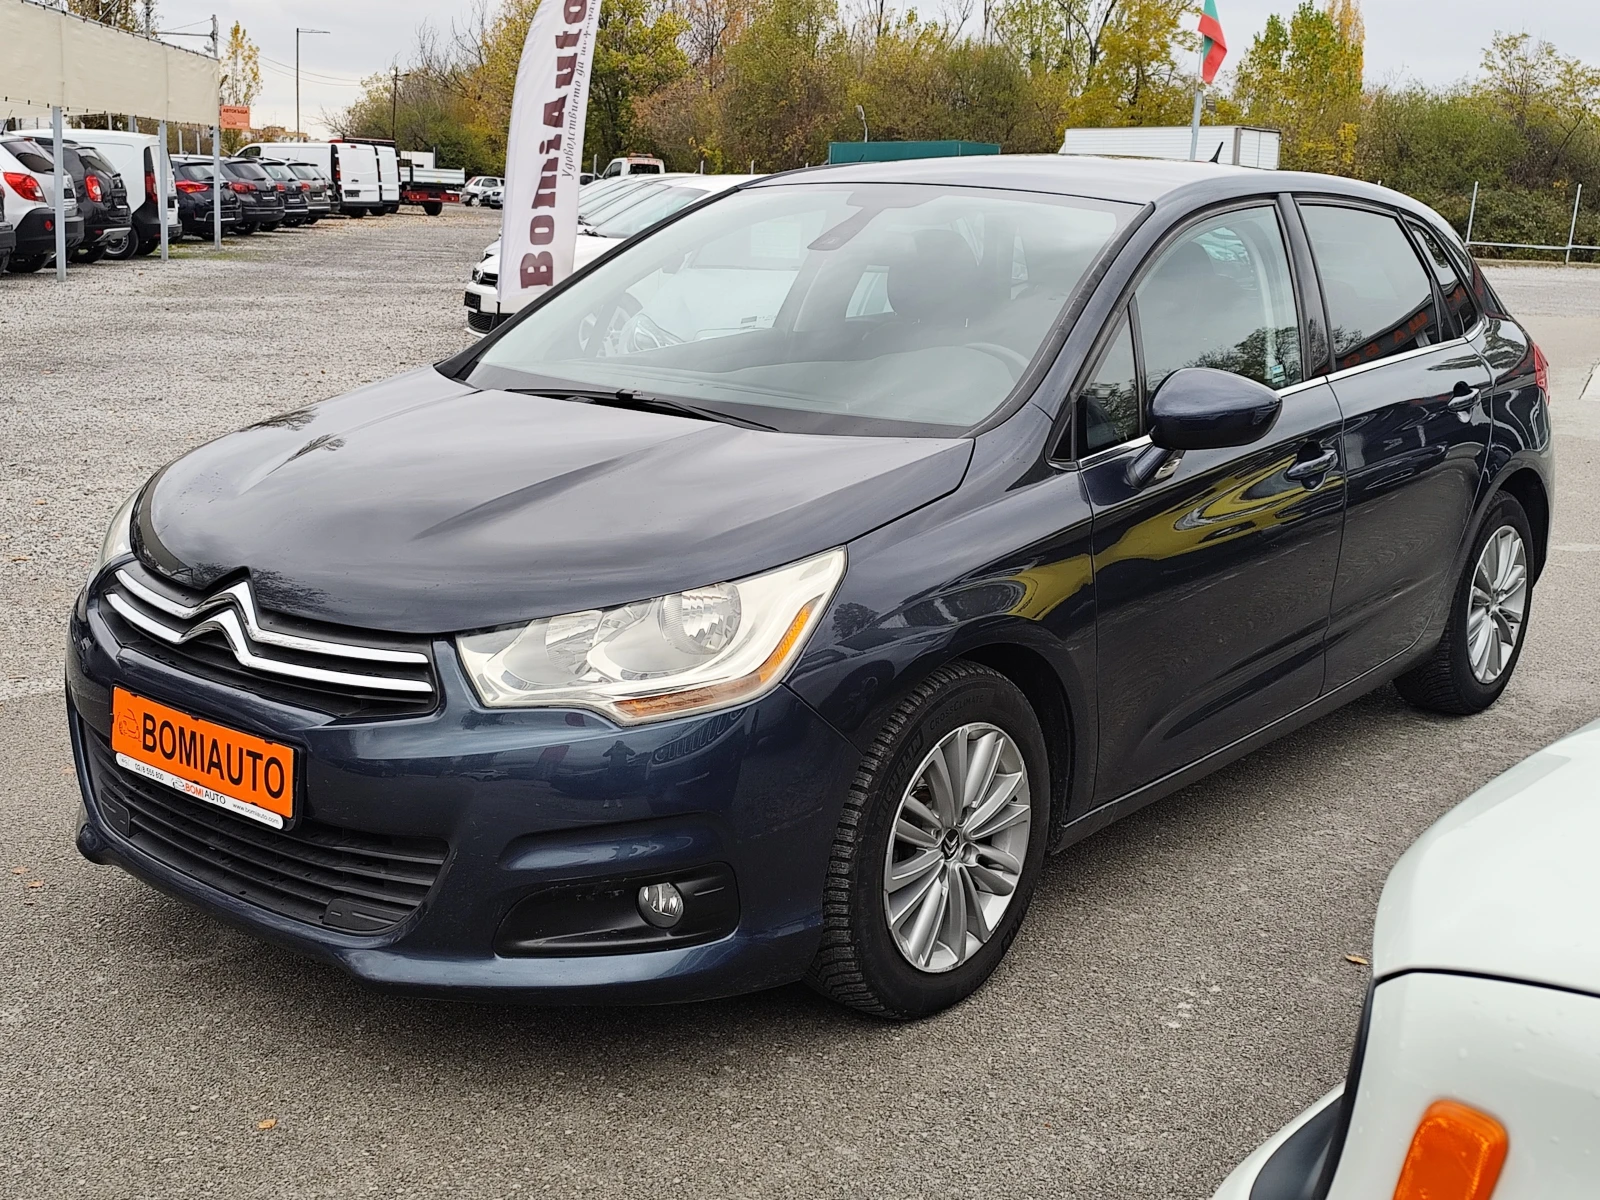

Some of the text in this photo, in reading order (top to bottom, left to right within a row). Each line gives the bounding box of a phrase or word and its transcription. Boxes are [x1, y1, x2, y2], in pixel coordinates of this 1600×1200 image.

[561, 80, 582, 180] Удоволствието
[575, 62, 586, 77] да
[142, 712, 285, 799] BOMIAUTO
[184, 783, 226, 805] BOMI AUTO
[875, 733, 923, 828] MICHELIN
[232, 803, 280, 825] www.bomiauto.com
